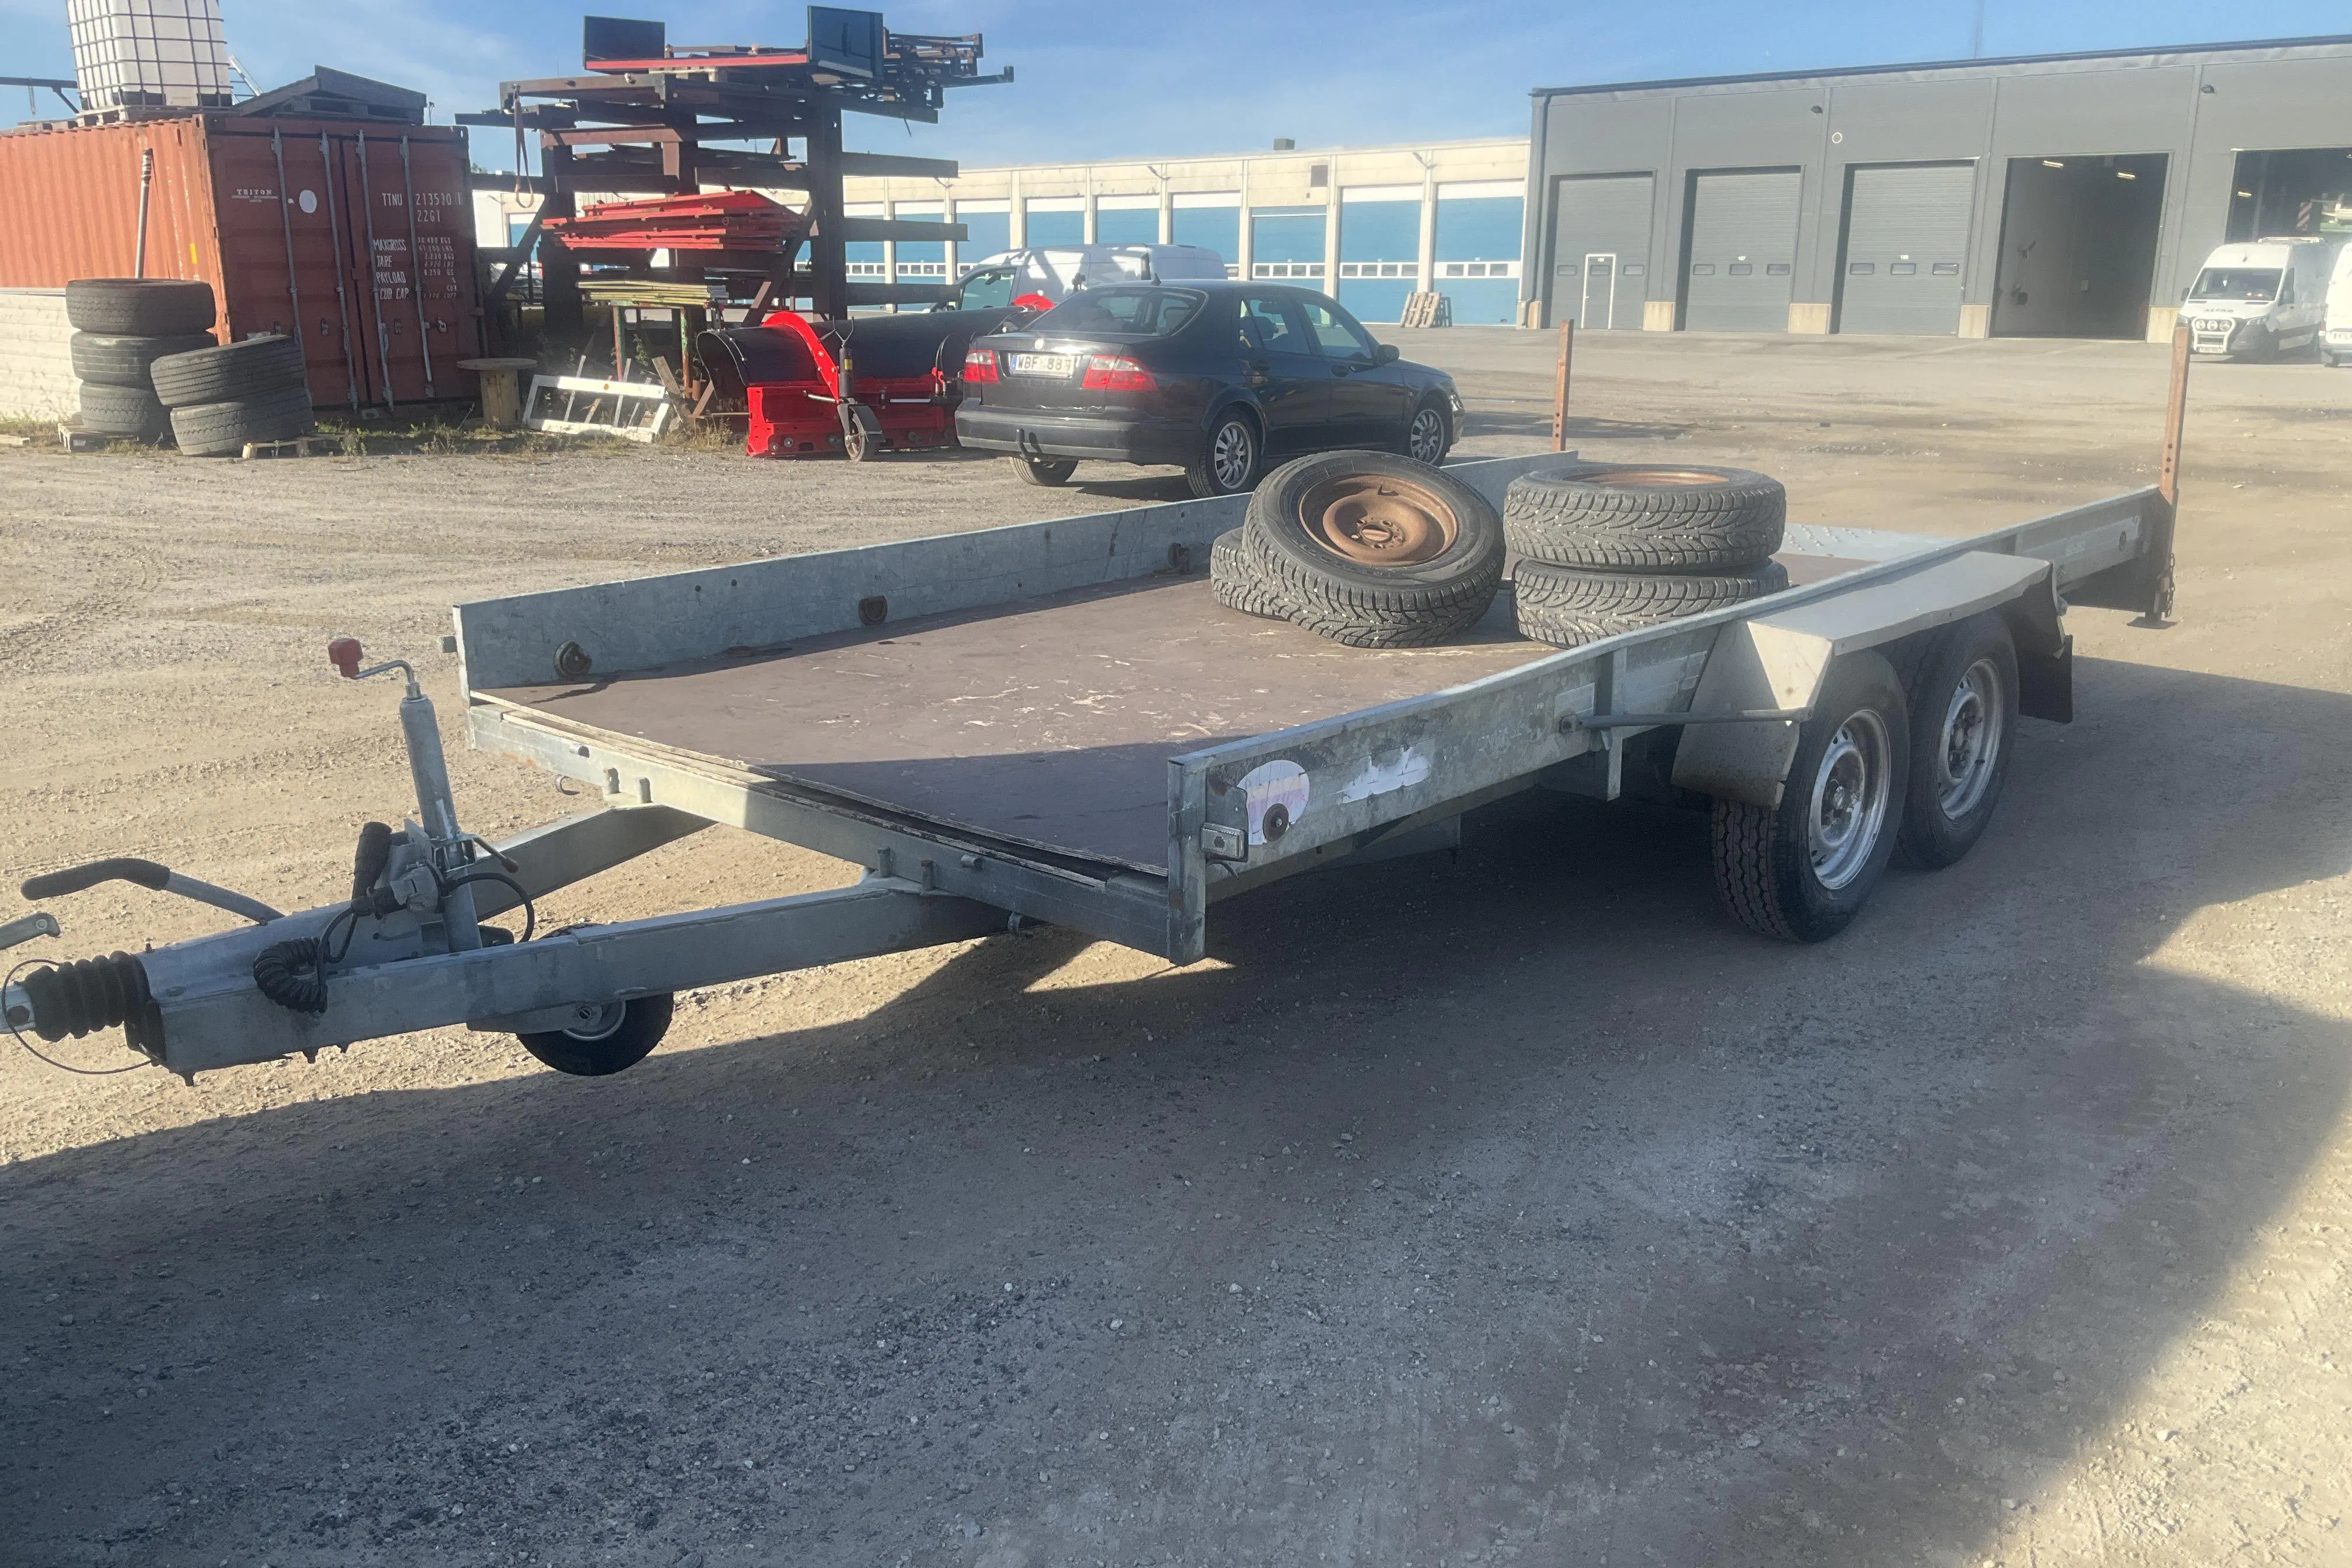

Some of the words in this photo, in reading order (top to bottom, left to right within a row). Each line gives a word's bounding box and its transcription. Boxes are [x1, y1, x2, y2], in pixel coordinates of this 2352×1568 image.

[382, 192, 403, 206] TTNU
[376, 255, 393, 268] TARE
[376, 271, 407, 284] PAYLOAD
[1018, 355, 1039, 369] WBF
